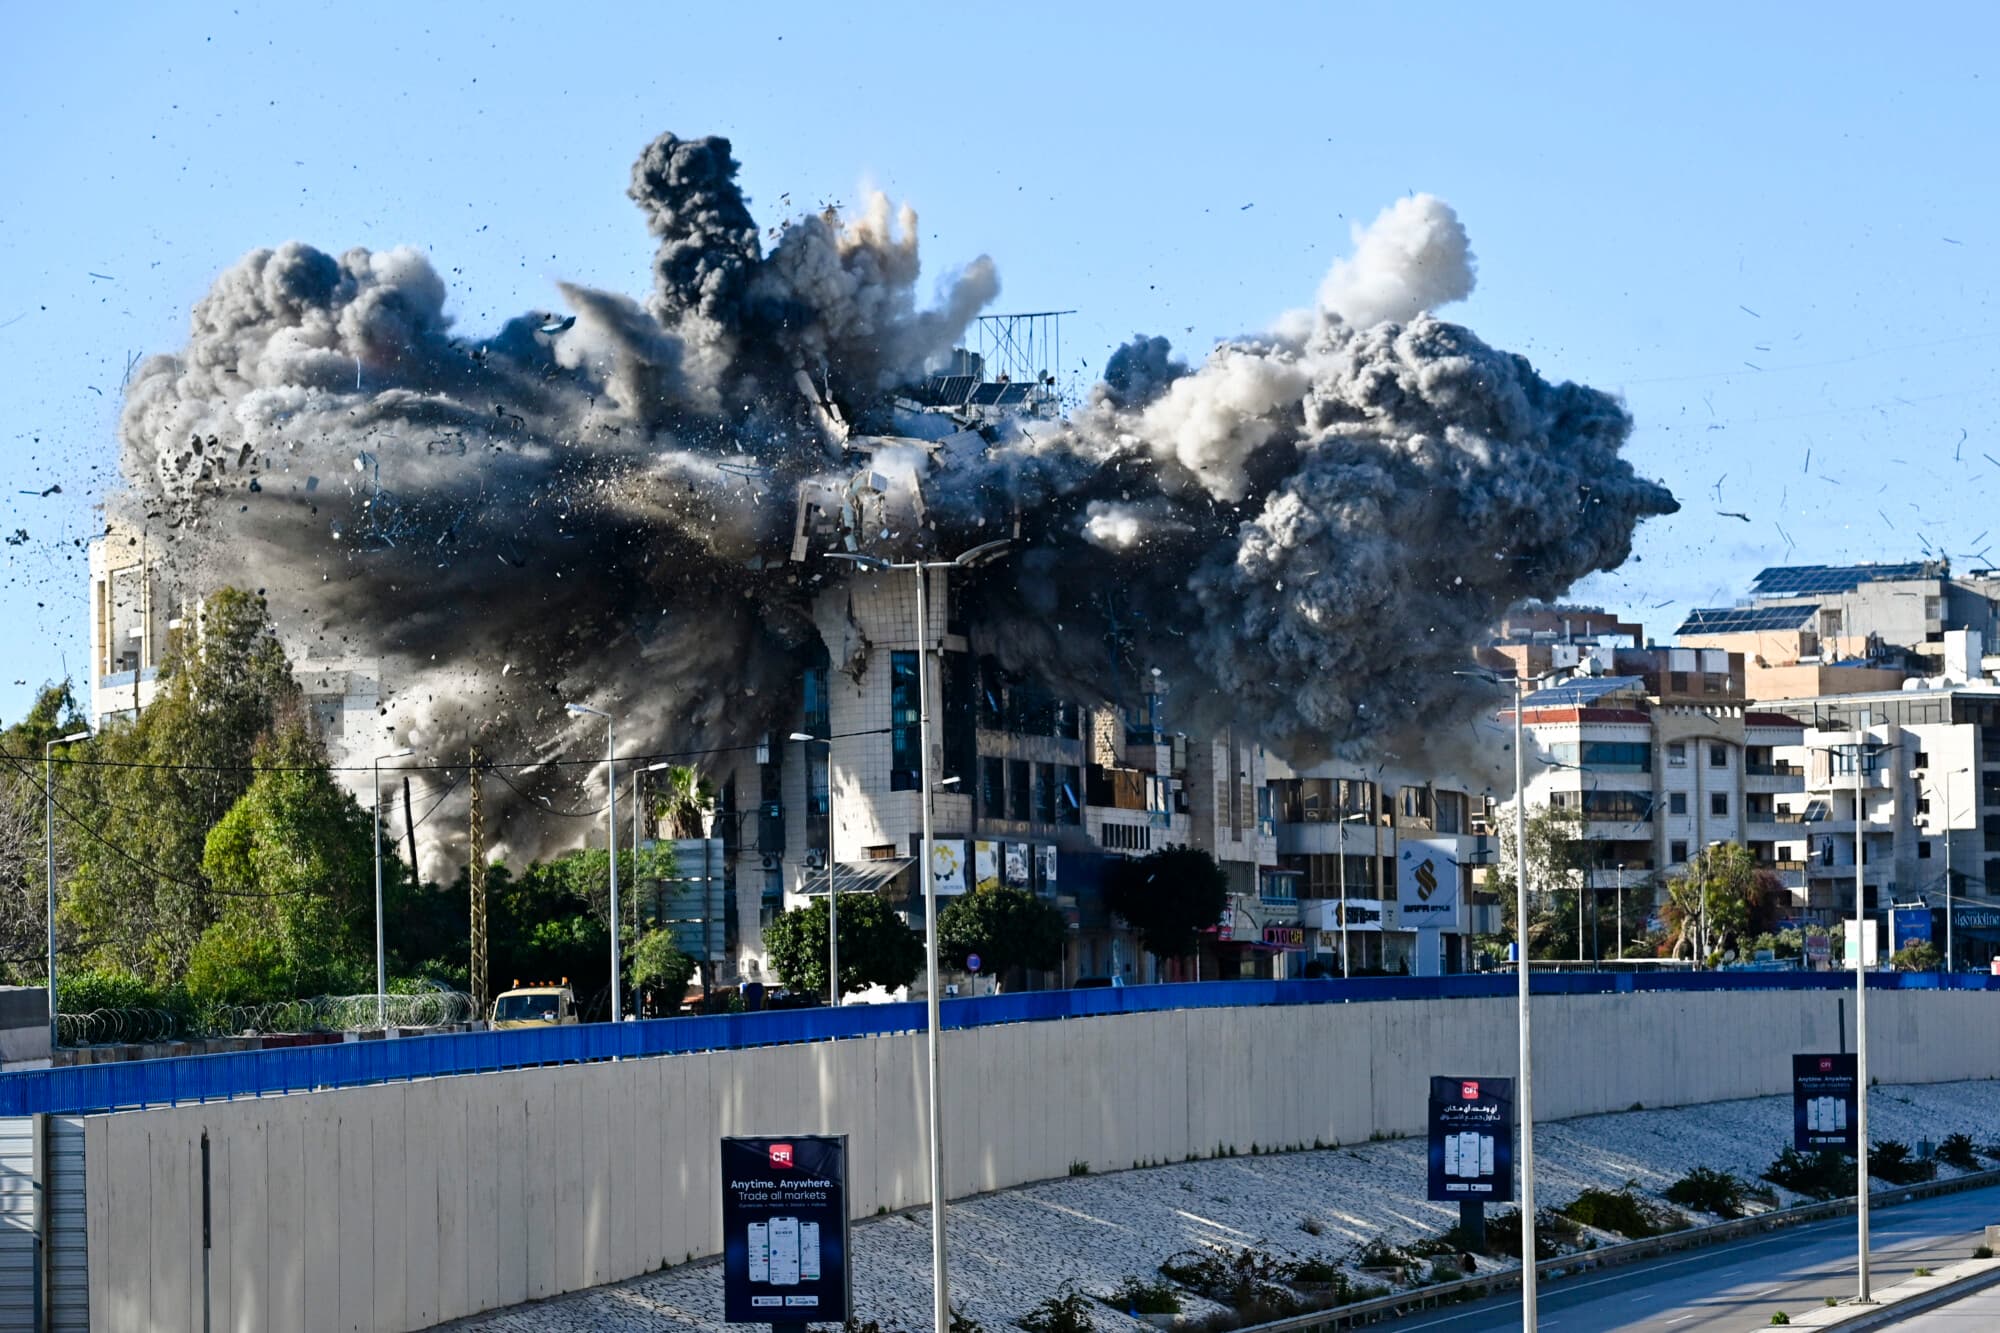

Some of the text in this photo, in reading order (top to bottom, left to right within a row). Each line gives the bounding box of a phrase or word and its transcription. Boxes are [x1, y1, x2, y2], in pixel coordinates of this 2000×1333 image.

[772, 1151, 790, 1162] CFI
[730, 1178, 834, 1192] Anytime. Anywhere.
[738, 1191, 827, 1201] Trade all markets
